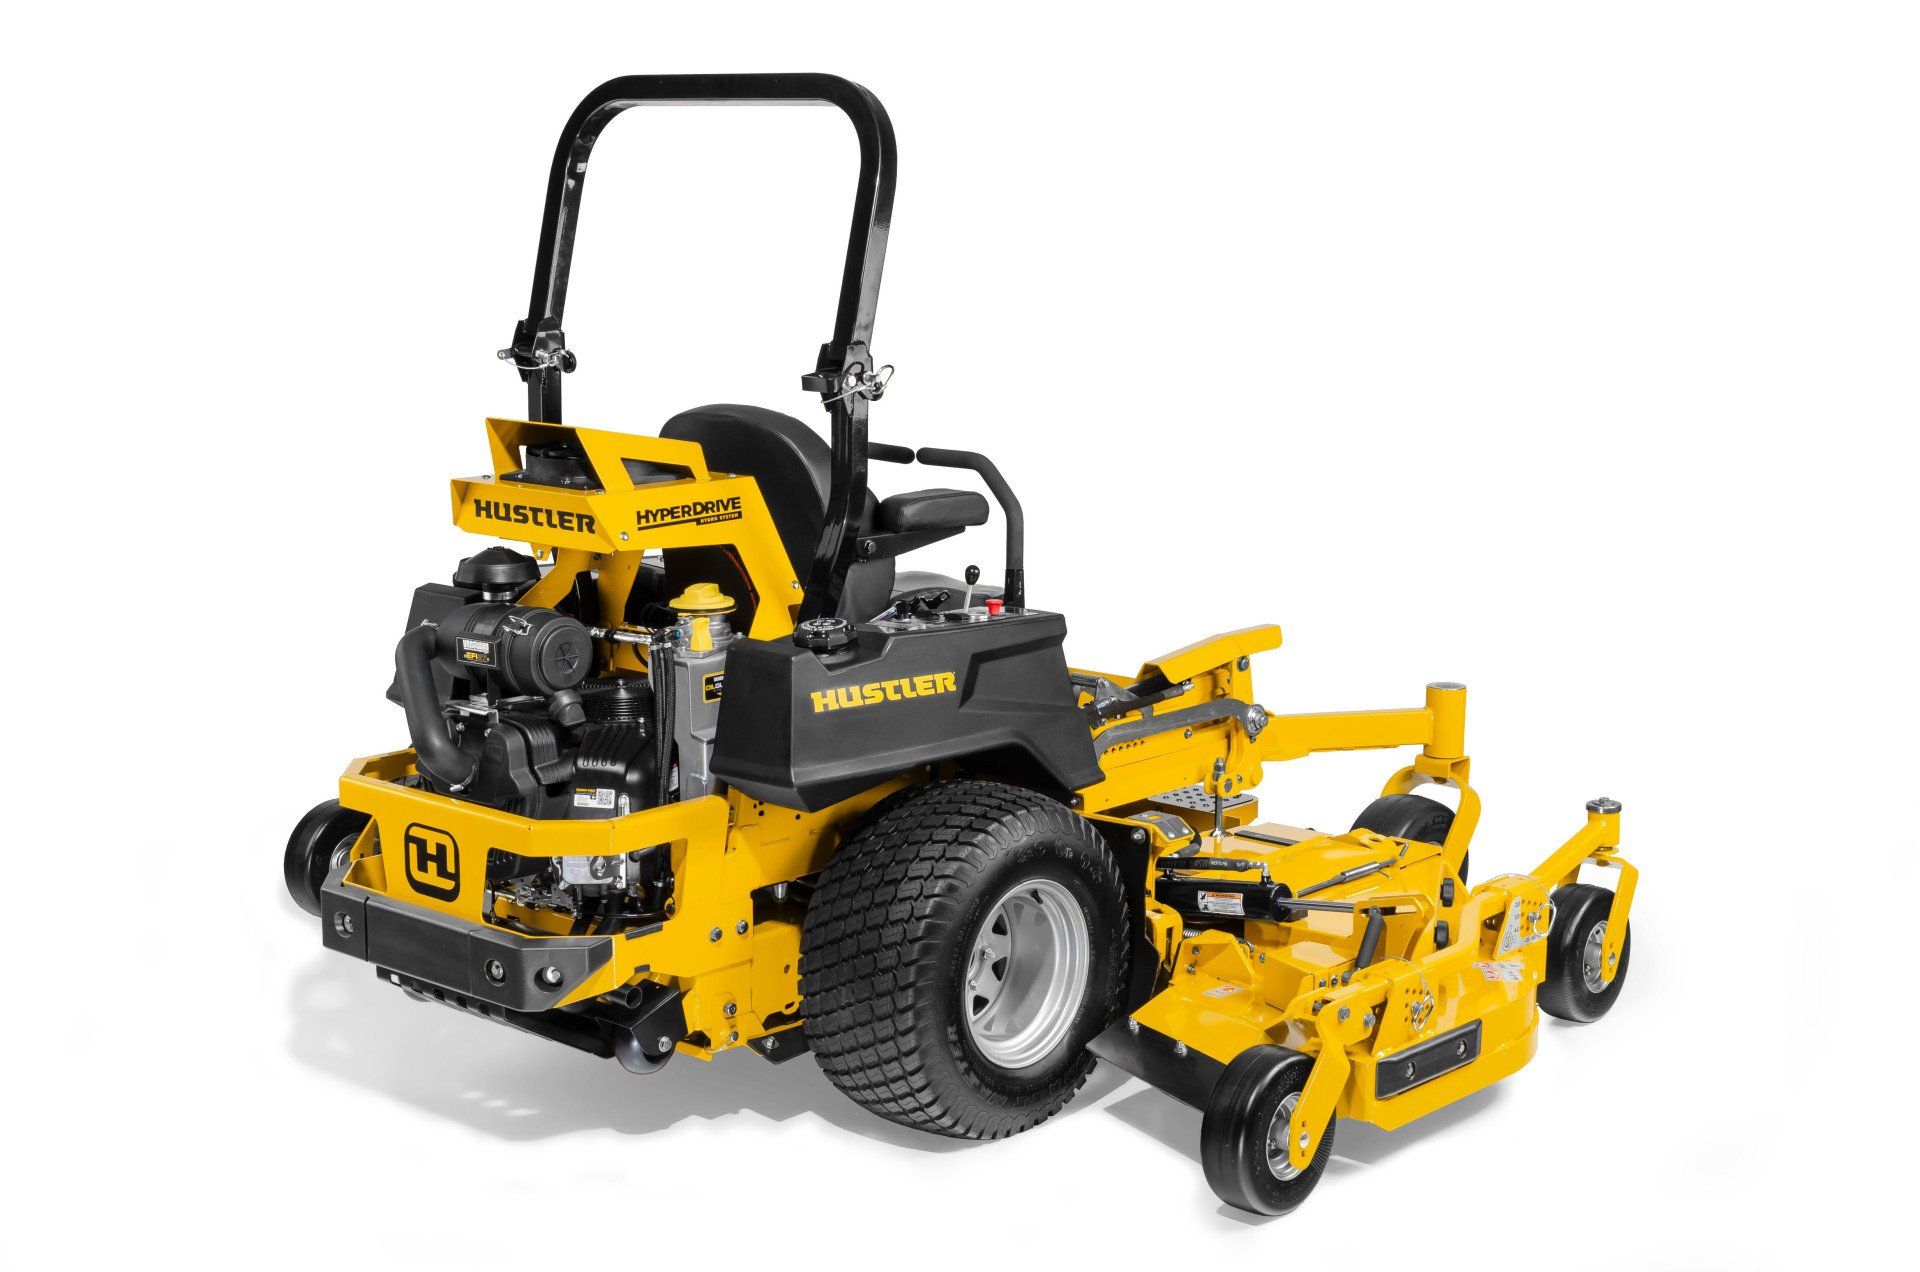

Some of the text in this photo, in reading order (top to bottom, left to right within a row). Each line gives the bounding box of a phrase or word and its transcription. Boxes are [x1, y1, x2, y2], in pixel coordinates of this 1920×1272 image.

[473, 498, 596, 535] HUSTLER
[636, 496, 742, 525] HYPERDRIVE
[700, 512, 739, 524] HYDRO SYSTEM
[810, 671, 957, 713] HUSTLER
